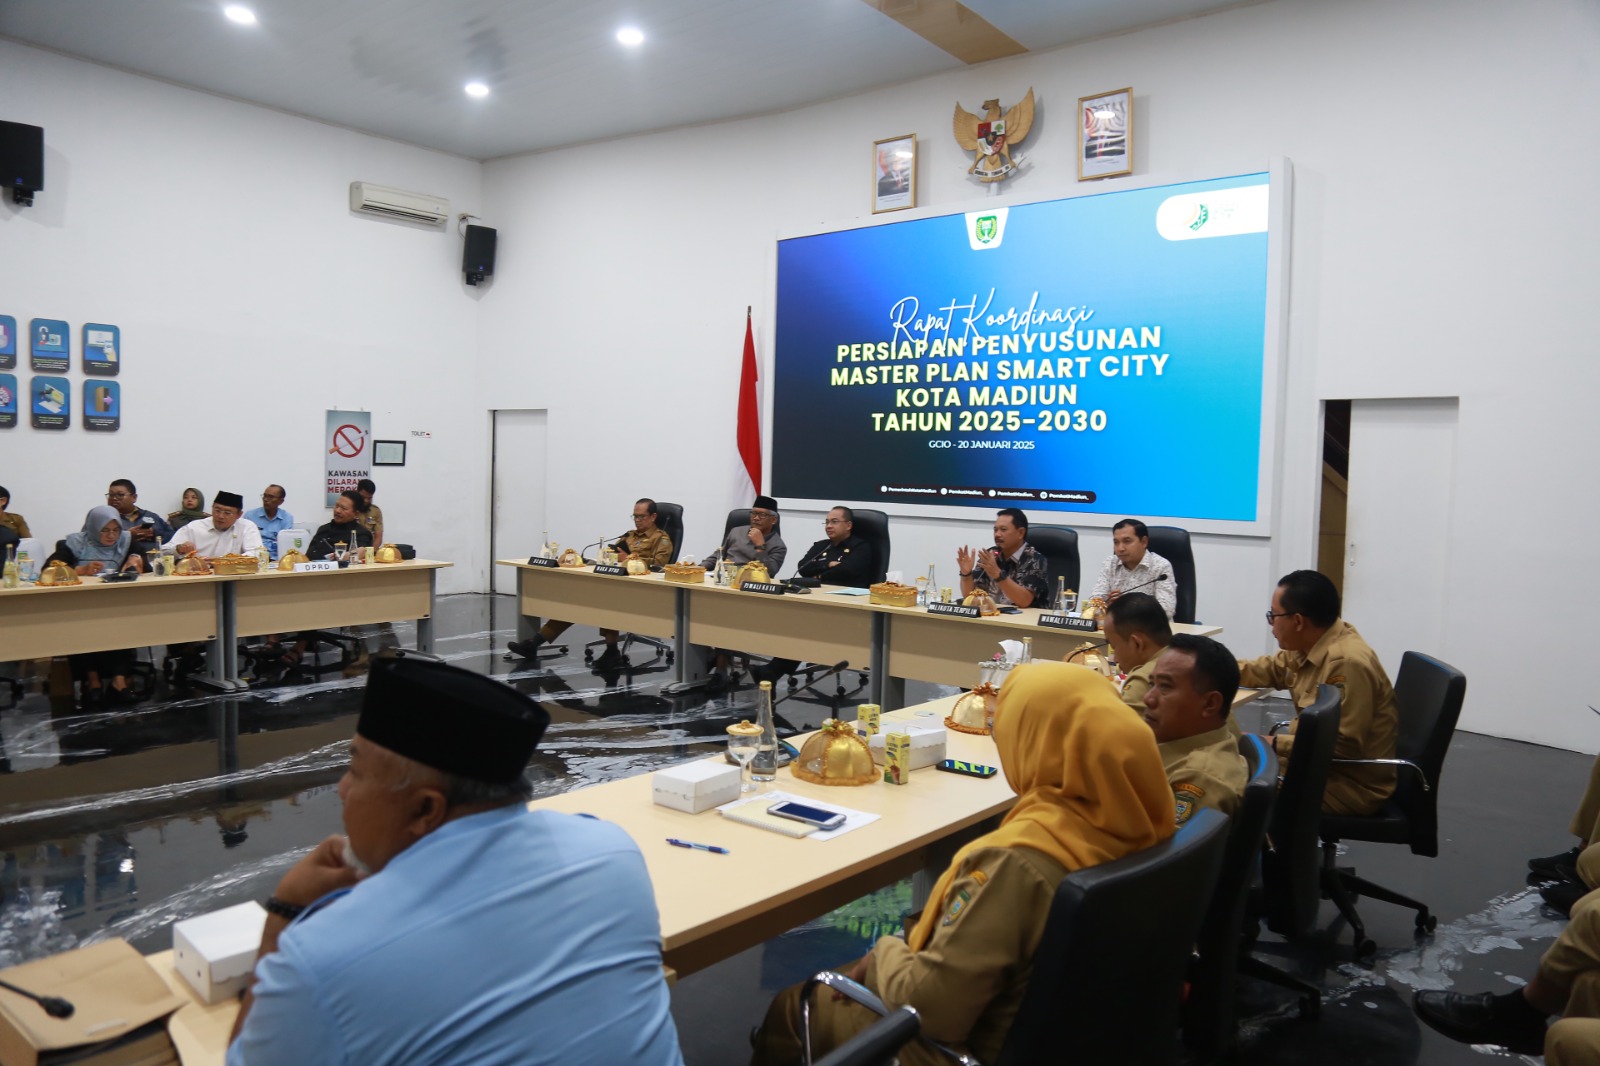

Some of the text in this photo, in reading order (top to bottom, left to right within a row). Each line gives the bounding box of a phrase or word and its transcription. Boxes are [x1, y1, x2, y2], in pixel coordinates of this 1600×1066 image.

[890, 287, 1094, 355] Rapat Koordinasi
[837, 326, 1160, 362] PERSIAPAN PENYUSUNAN
[831, 353, 1170, 386] MASTER PLAN SMART CITY
[896, 384, 1077, 407] KOTA MADIUN
[872, 409, 1107, 432] TAHUN 2025-2030
[928, 440, 951, 449] GCIO
[958, 440, 969, 449] 20
[970, 440, 1011, 449] JANUARI
[1012, 440, 1035, 450] 2025
[305, 563, 330, 571] DPRD
[1041, 615, 1093, 627] WAWALI TERPILIH
